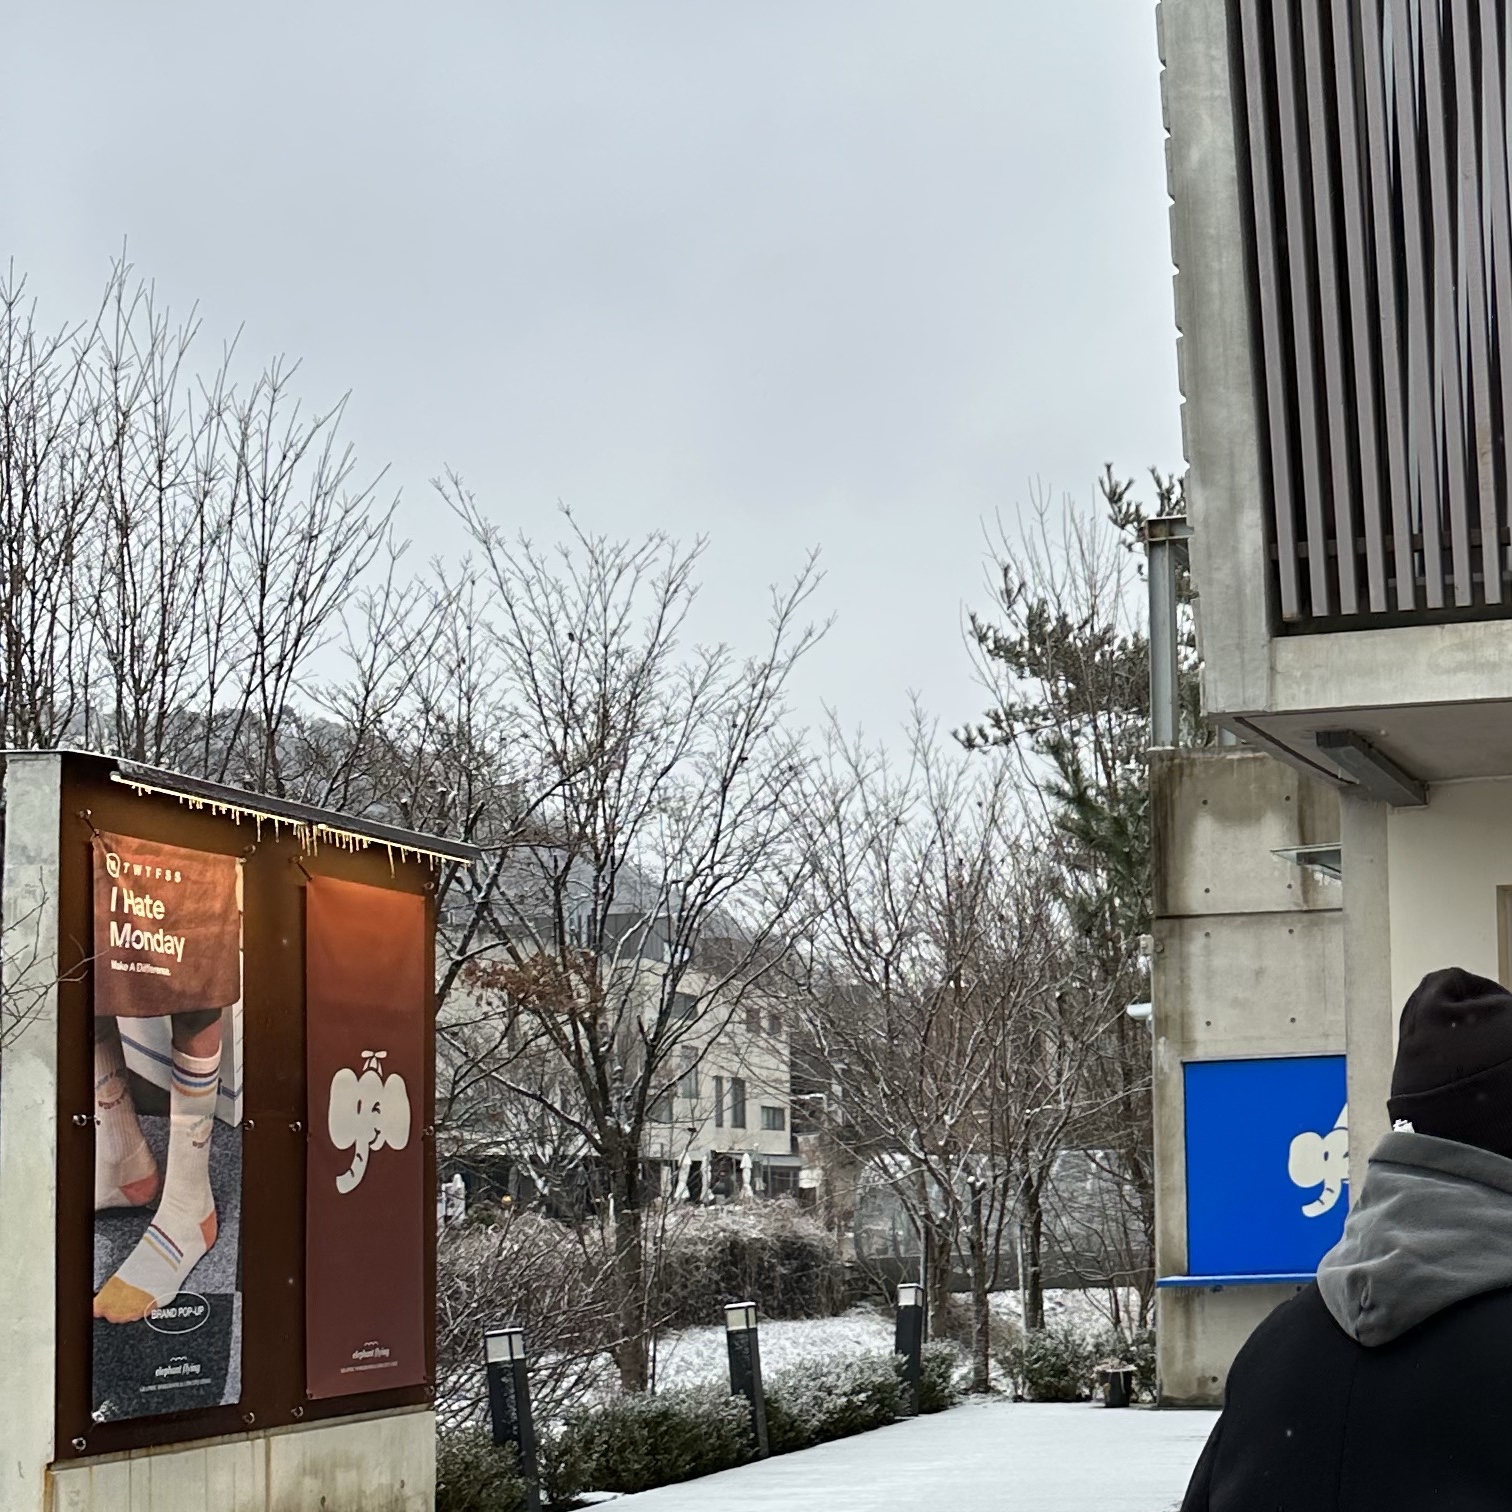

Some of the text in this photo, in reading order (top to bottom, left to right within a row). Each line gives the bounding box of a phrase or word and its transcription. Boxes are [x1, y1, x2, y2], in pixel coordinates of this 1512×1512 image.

[110, 886, 165, 920] I Hate
[110, 921, 185, 962] Monday
